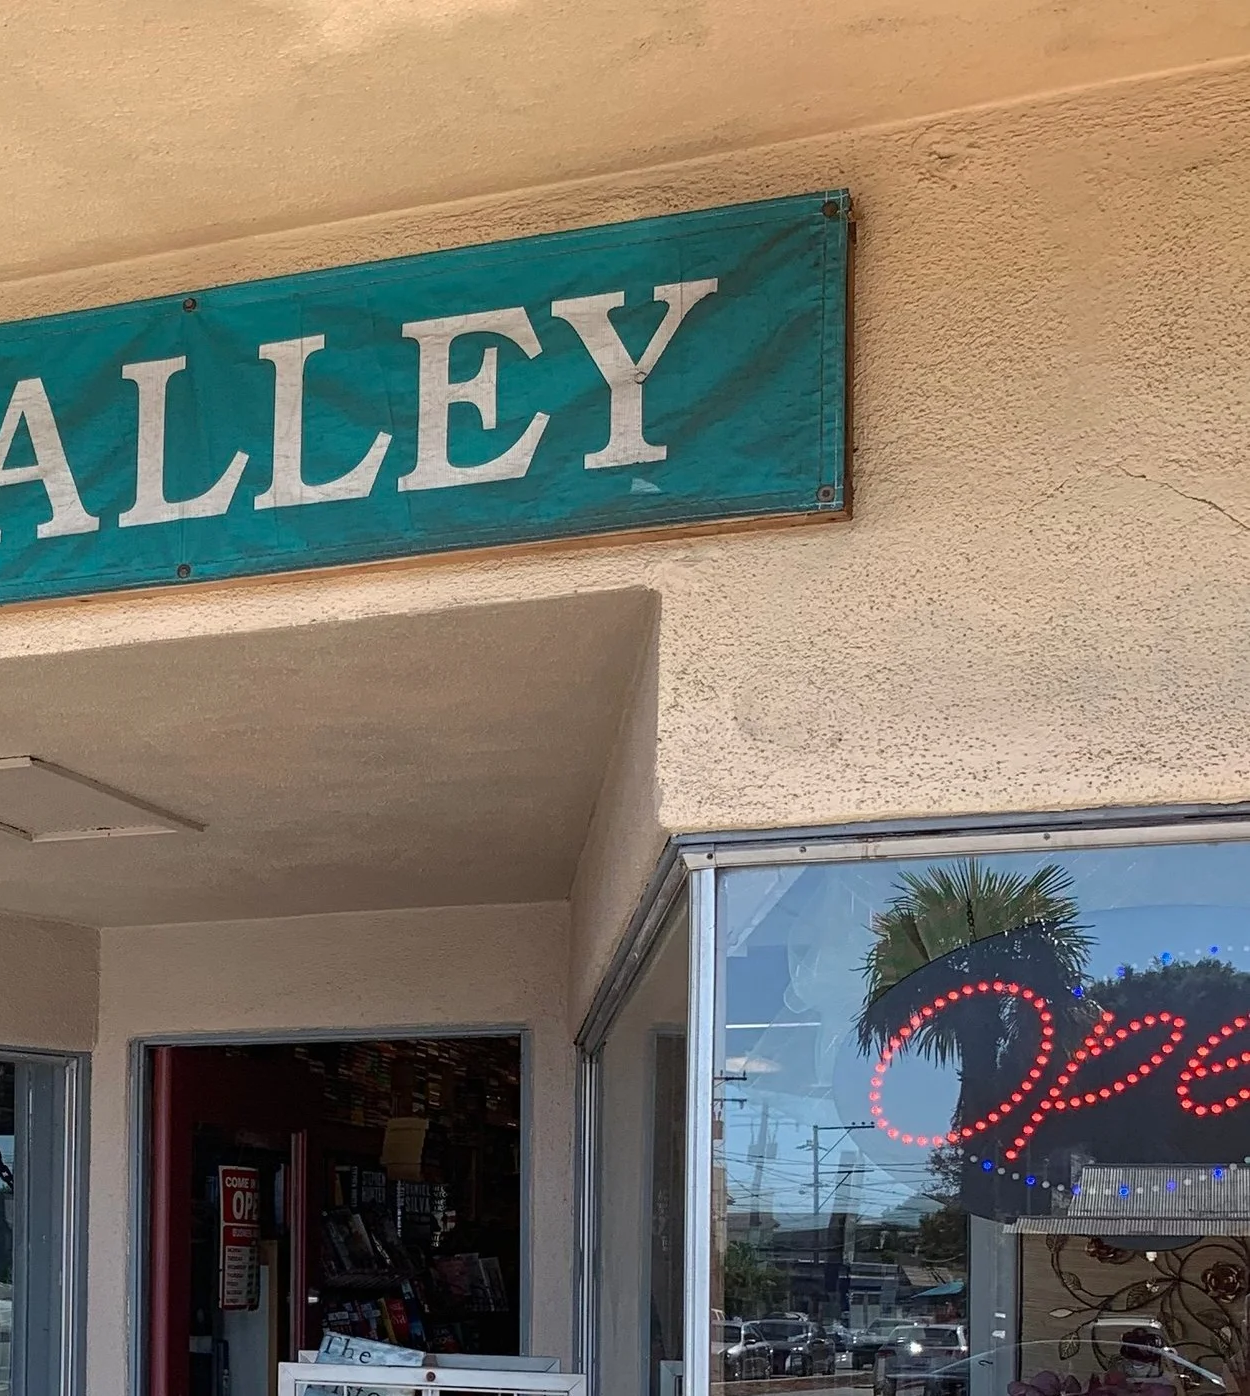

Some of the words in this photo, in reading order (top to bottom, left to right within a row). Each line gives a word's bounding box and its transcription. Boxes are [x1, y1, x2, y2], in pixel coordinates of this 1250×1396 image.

[225, 1176, 249, 1188] COME
[405, 1196, 431, 1213] SILVA
[323, 1334, 372, 1364] The
